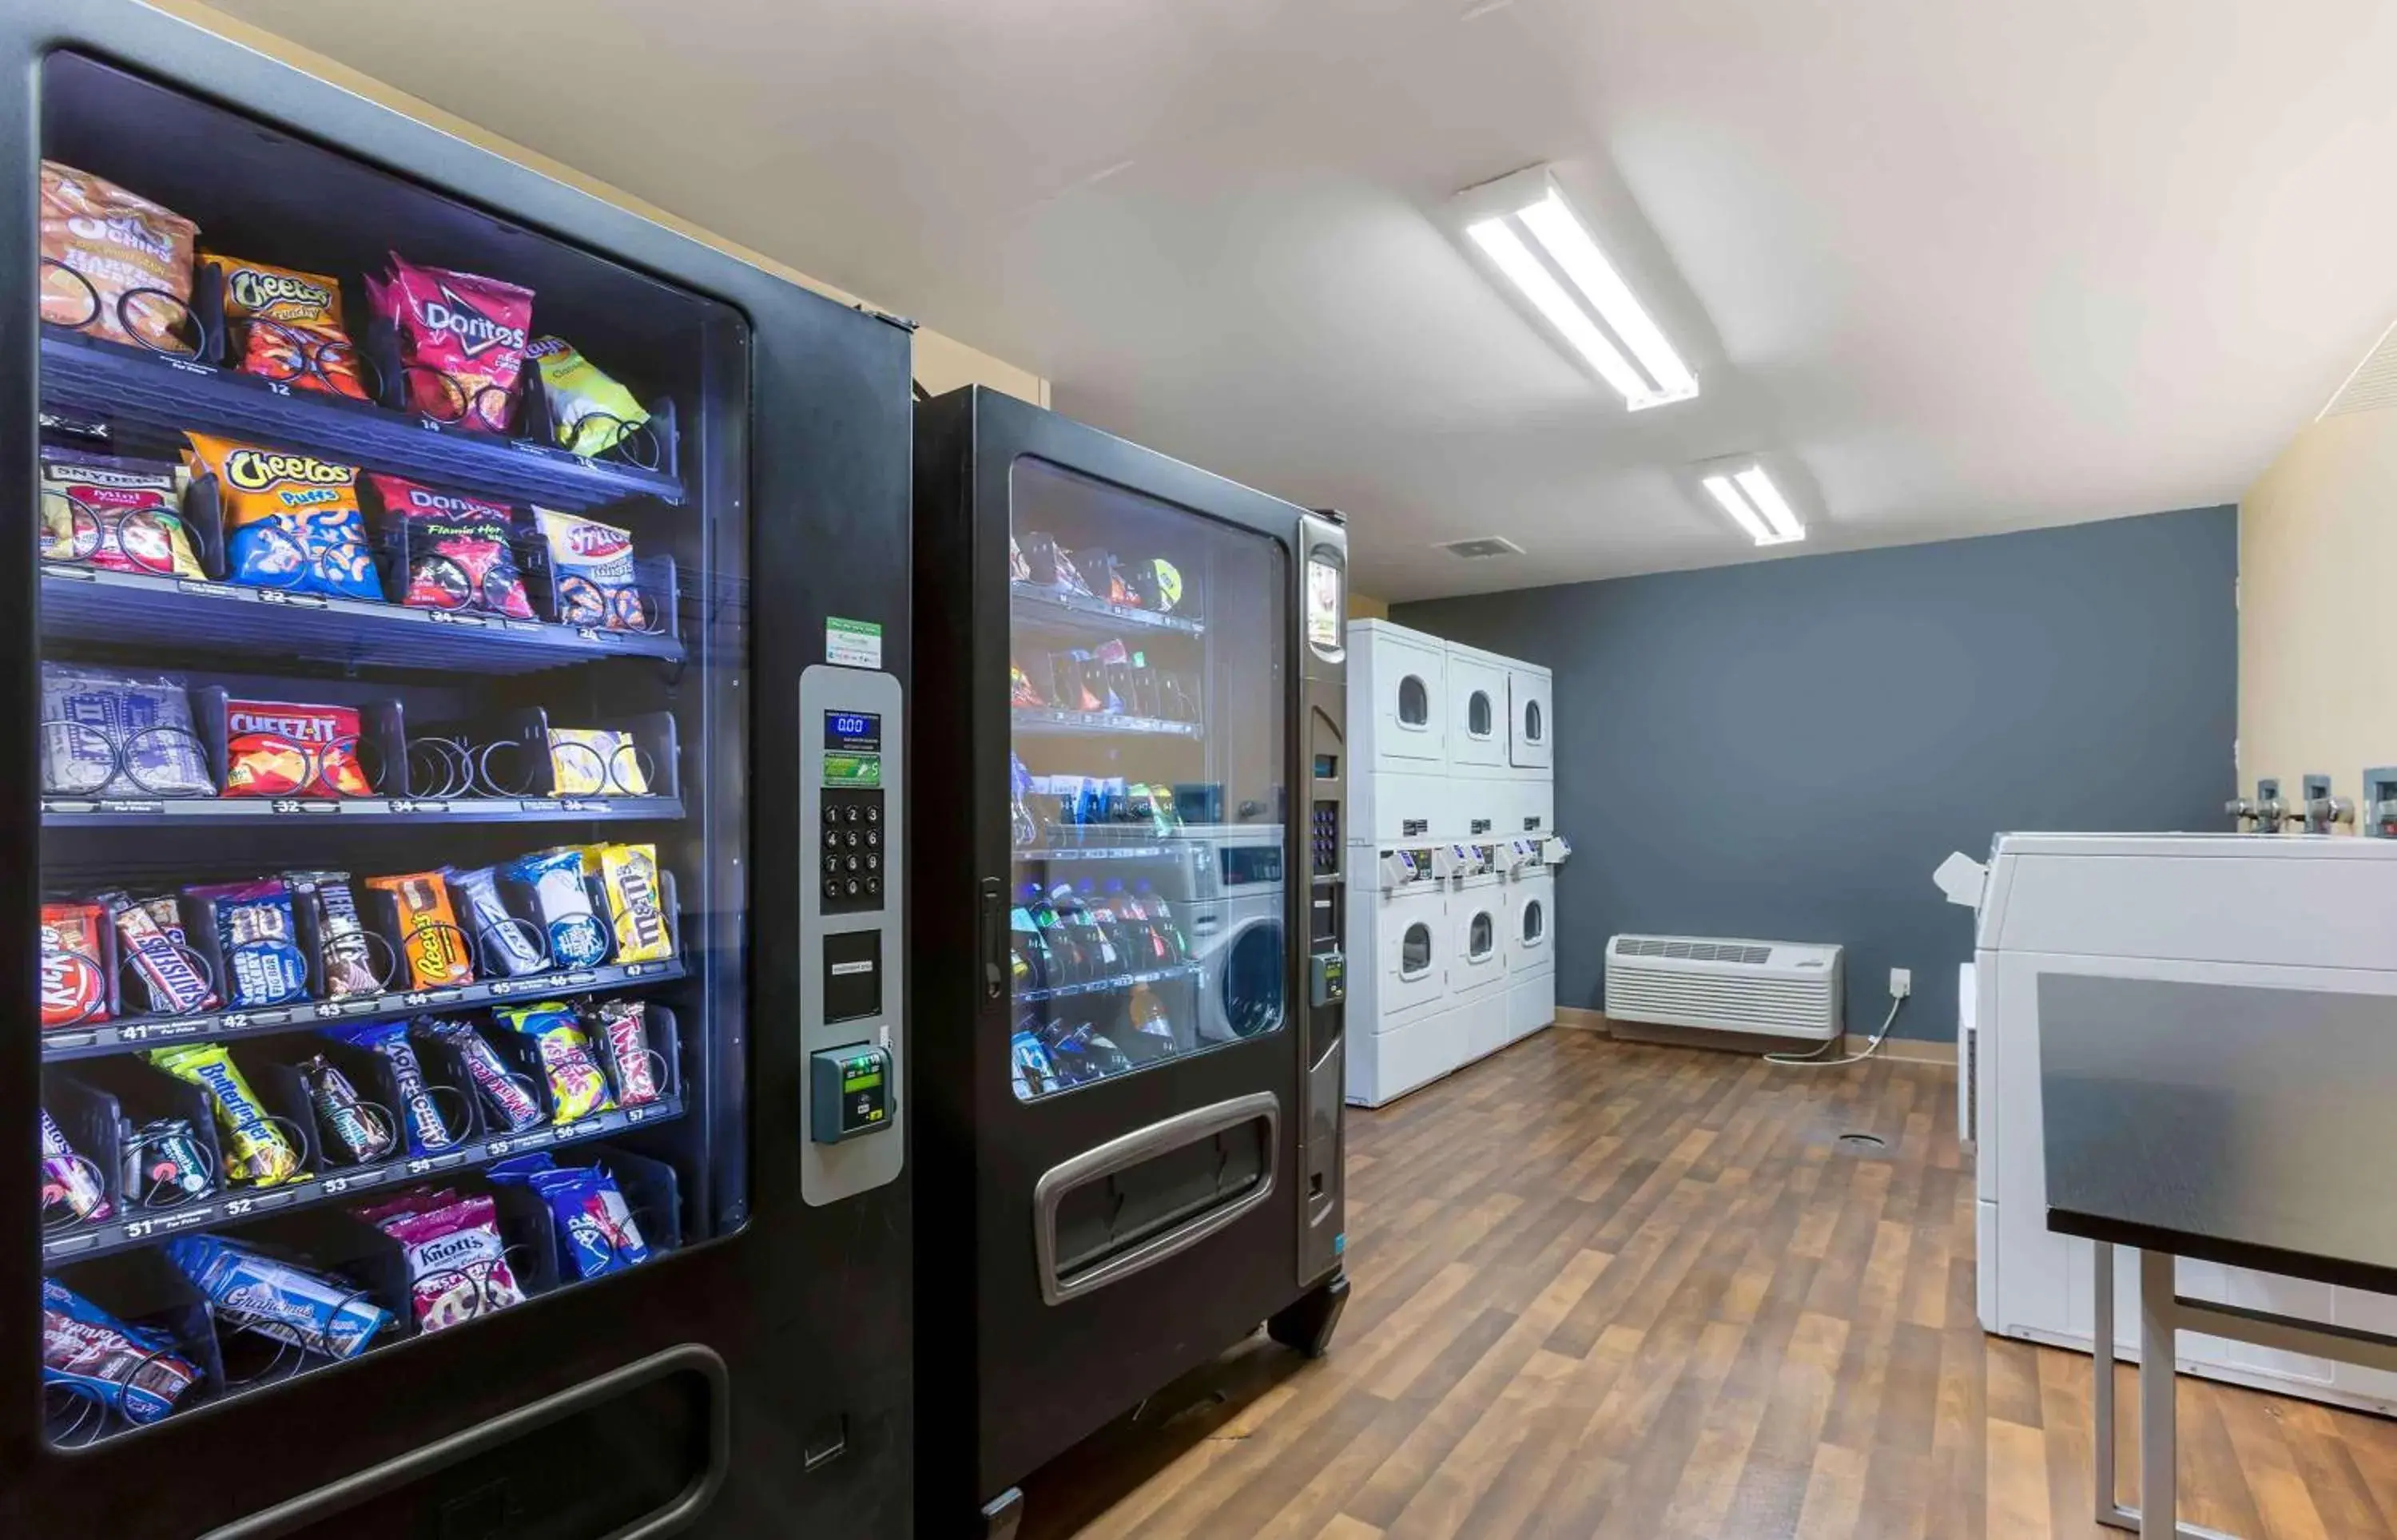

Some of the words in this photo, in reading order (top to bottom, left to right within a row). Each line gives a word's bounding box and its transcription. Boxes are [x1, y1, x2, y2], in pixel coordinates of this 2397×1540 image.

[231, 270, 331, 309] Cheetos
[427, 302, 525, 350] Doritos
[268, 381, 291, 396] 12
[421, 419, 439, 432] 14
[229, 450, 352, 487] Cheetos
[93, 489, 141, 501] Mini
[280, 490, 338, 506] Puffs
[276, 800, 300, 813] 32
[830, 808, 836, 821] 1
[849, 808, 857, 821] 2
[869, 808, 877, 821] 3
[829, 833, 837, 846] 4
[849, 832, 857, 847] 5
[869, 832, 877, 844] 6
[829, 858, 837, 871] 7
[849, 856, 857, 870] 8
[849, 880, 857, 894] 0
[320, 886, 371, 960] HERSHEY'S
[411, 913, 447, 978] Reese's
[265, 957, 277, 976] BAR
[626, 965, 641, 977] 47
[492, 982, 511, 994] 45
[318, 1004, 341, 1017] 43
[223, 1014, 248, 1028] 42
[123, 1024, 149, 1039] 41
[197, 1062, 272, 1141] Butterfinger
[629, 1109, 644, 1121] 57
[557, 1125, 574, 1138] 56
[324, 1180, 348, 1193] 53
[226, 1198, 252, 1215] 52
[126, 1221, 155, 1238] 51
[420, 1236, 484, 1266] Knott's
[221, 1286, 316, 1318] Grandma's
